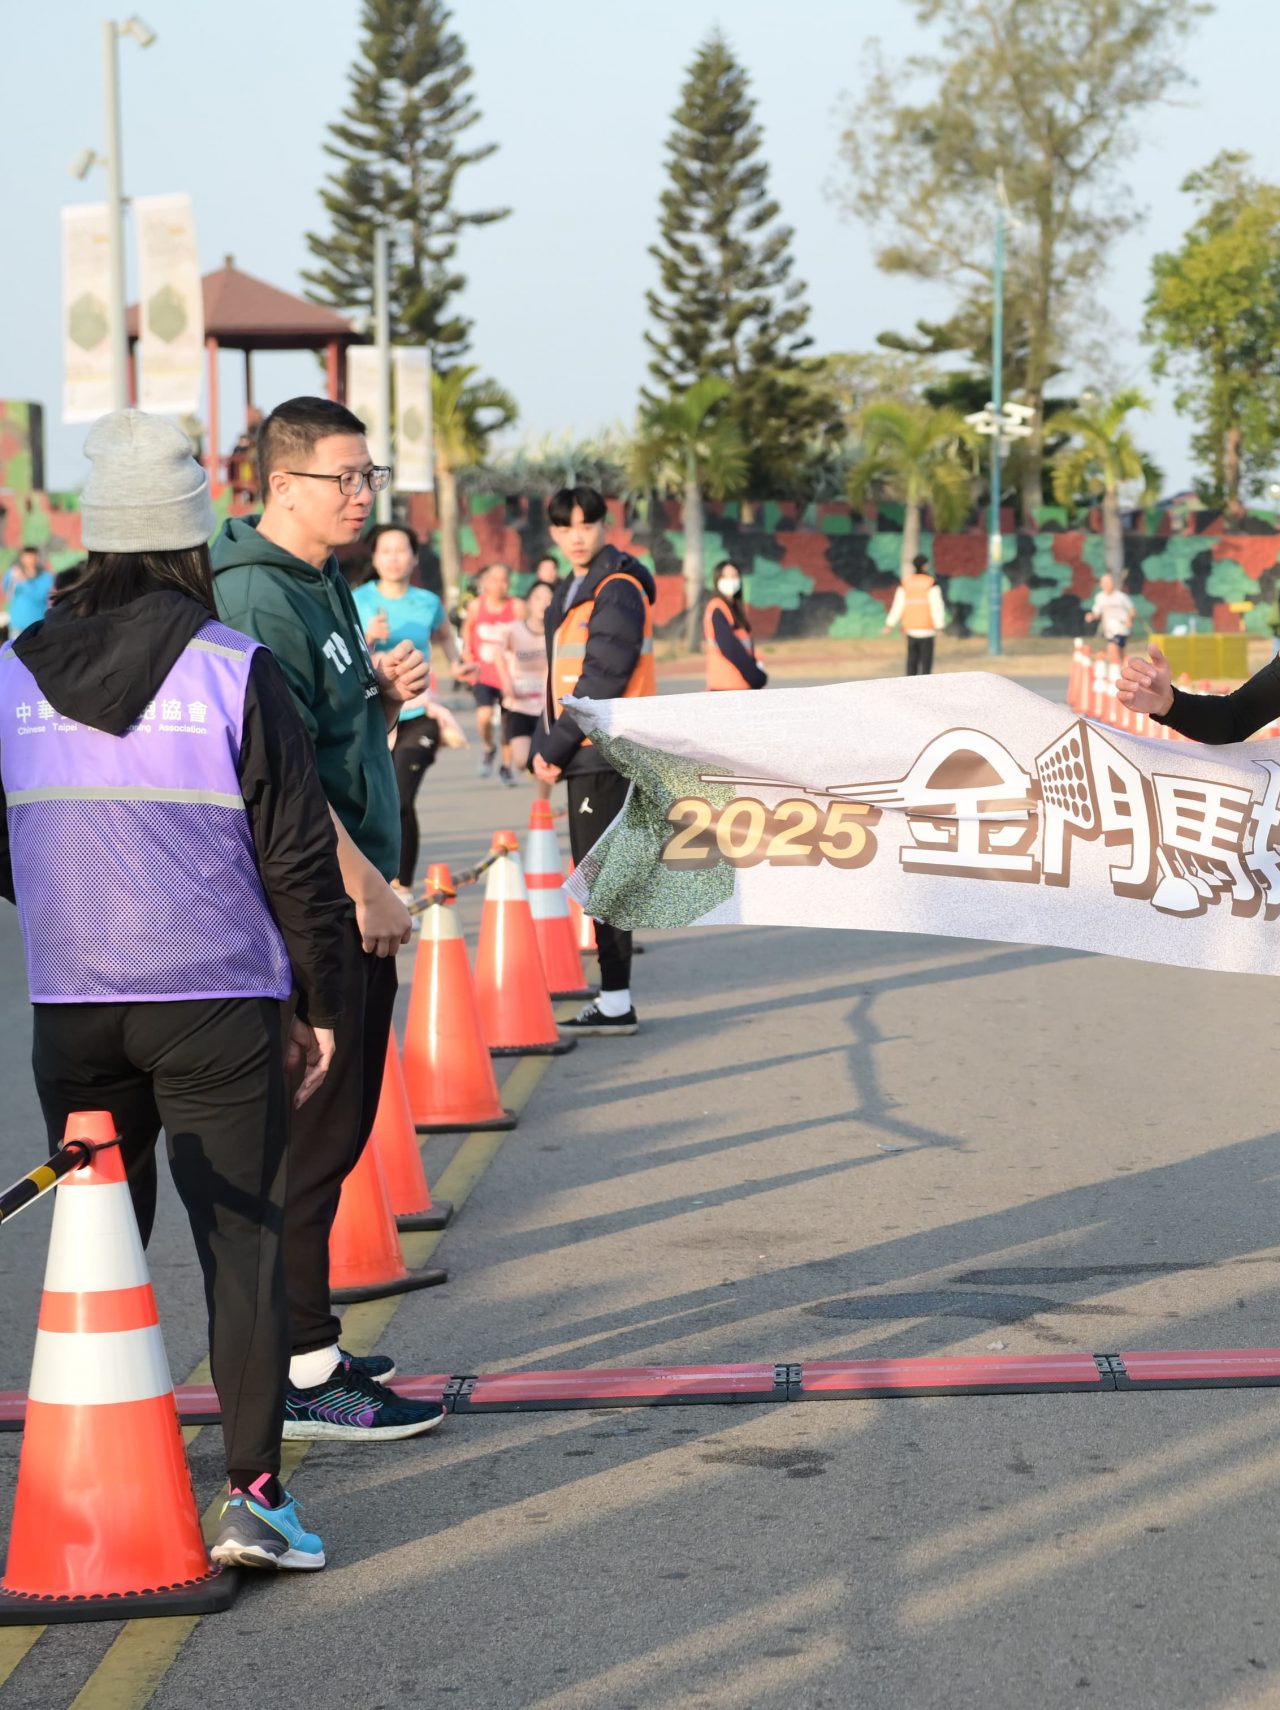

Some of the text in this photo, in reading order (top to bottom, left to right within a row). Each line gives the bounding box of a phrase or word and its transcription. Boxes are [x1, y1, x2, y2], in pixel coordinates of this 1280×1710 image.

[17, 725, 47, 735] Chinese
[52, 722, 78, 733] Taipei
[158, 723, 207, 734] Association
[661, 797, 882, 869] 2025
